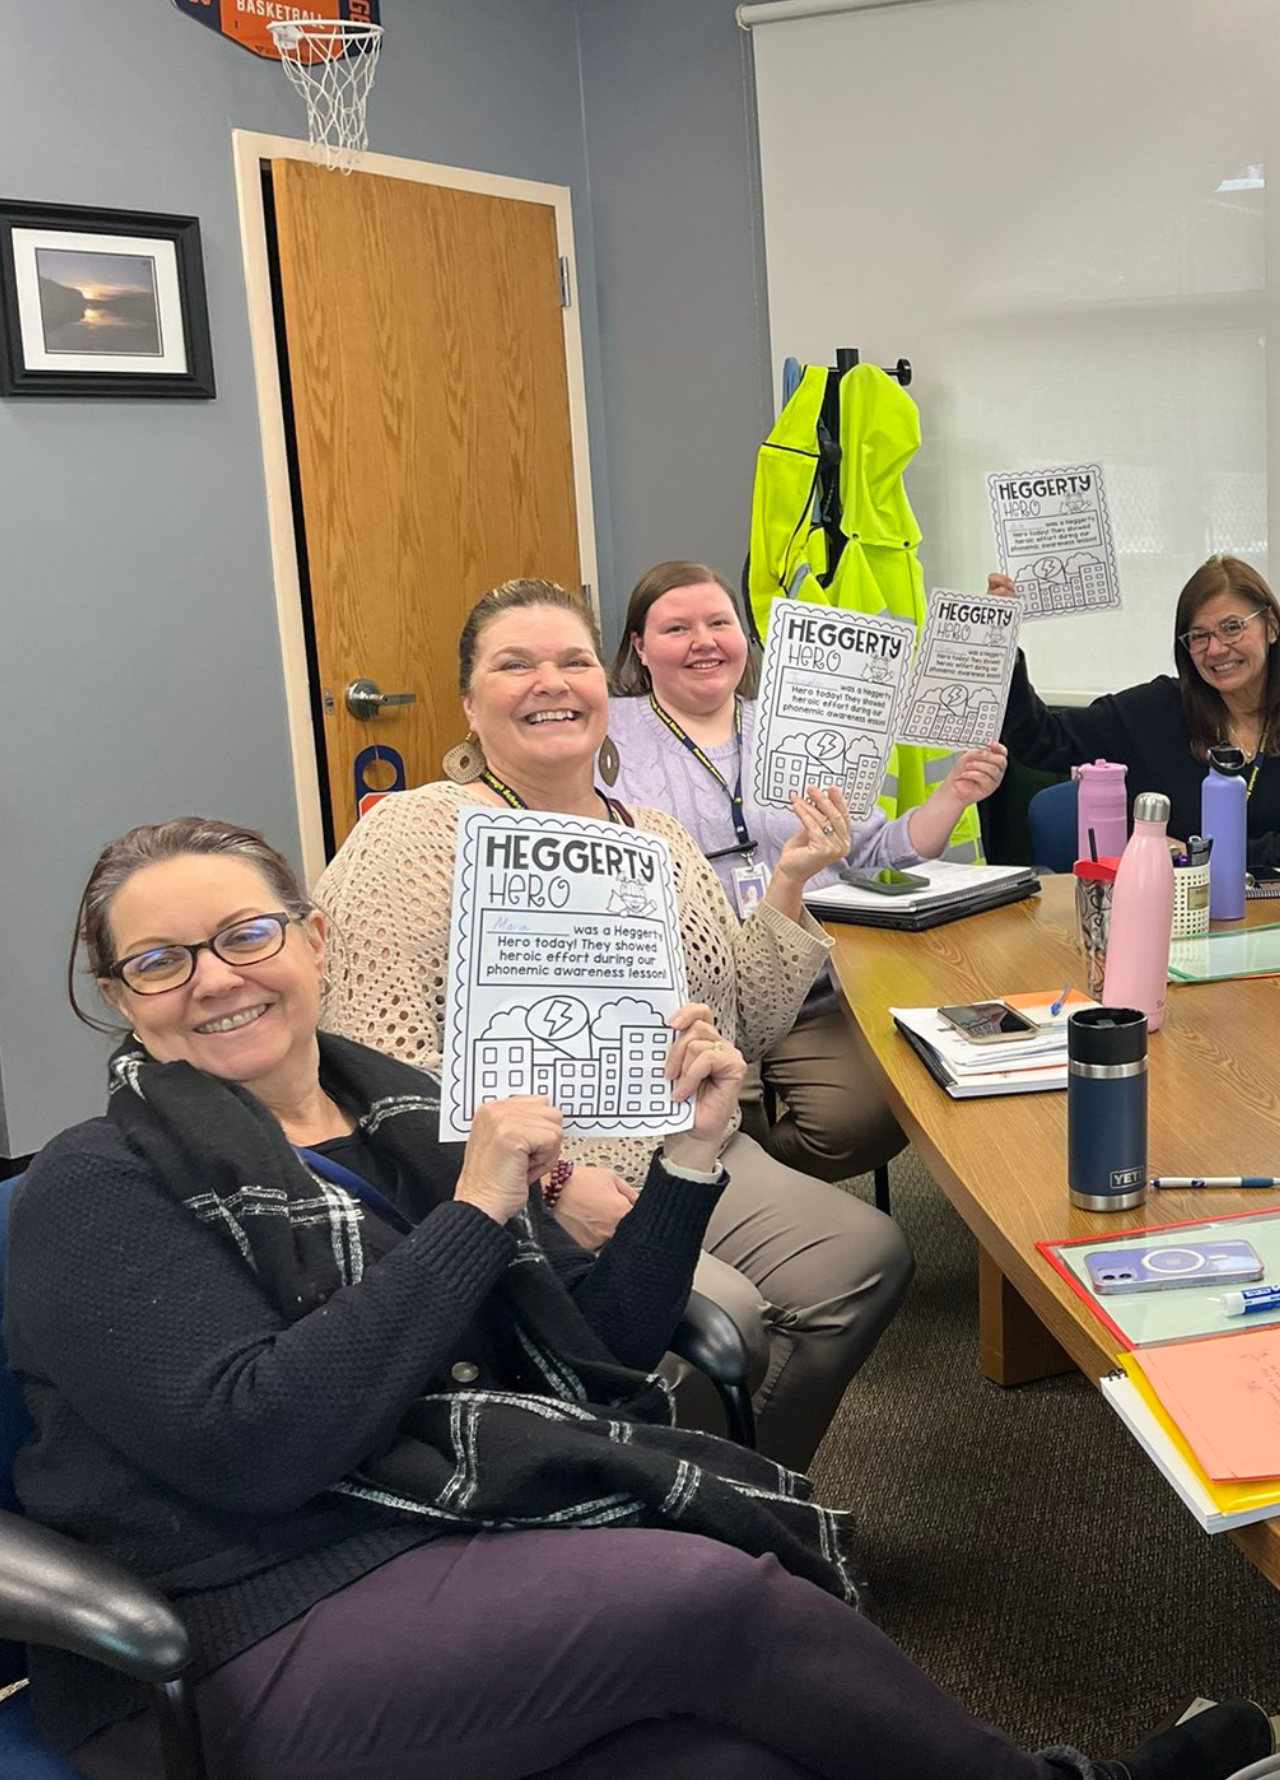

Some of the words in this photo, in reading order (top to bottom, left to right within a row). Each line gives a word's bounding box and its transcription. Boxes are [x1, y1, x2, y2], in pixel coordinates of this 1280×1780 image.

[237, 0, 325, 28] BASKETBALL
[999, 475, 1090, 500] HEGGERTY
[939, 603, 1013, 626] HEGGERTY
[788, 620, 901, 658] HEGGERTY
[486, 835, 654, 882] HEGGERTY
[574, 927, 598, 935] was
[615, 927, 662, 941] Heggerty
[498, 936, 530, 946] Hero
[536, 938, 576, 950] today!
[582, 939, 611, 950] They
[615, 941, 657, 952] showed
[500, 951, 541, 961] heroic
[547, 952, 589, 963] effort
[594, 954, 633, 966] during
[638, 956, 655, 965] our
[487, 964, 549, 977] phonemic
[554, 966, 624, 978] awareness
[629, 968, 666, 979] lesson!
[1113, 1170, 1142, 1185] YETI
